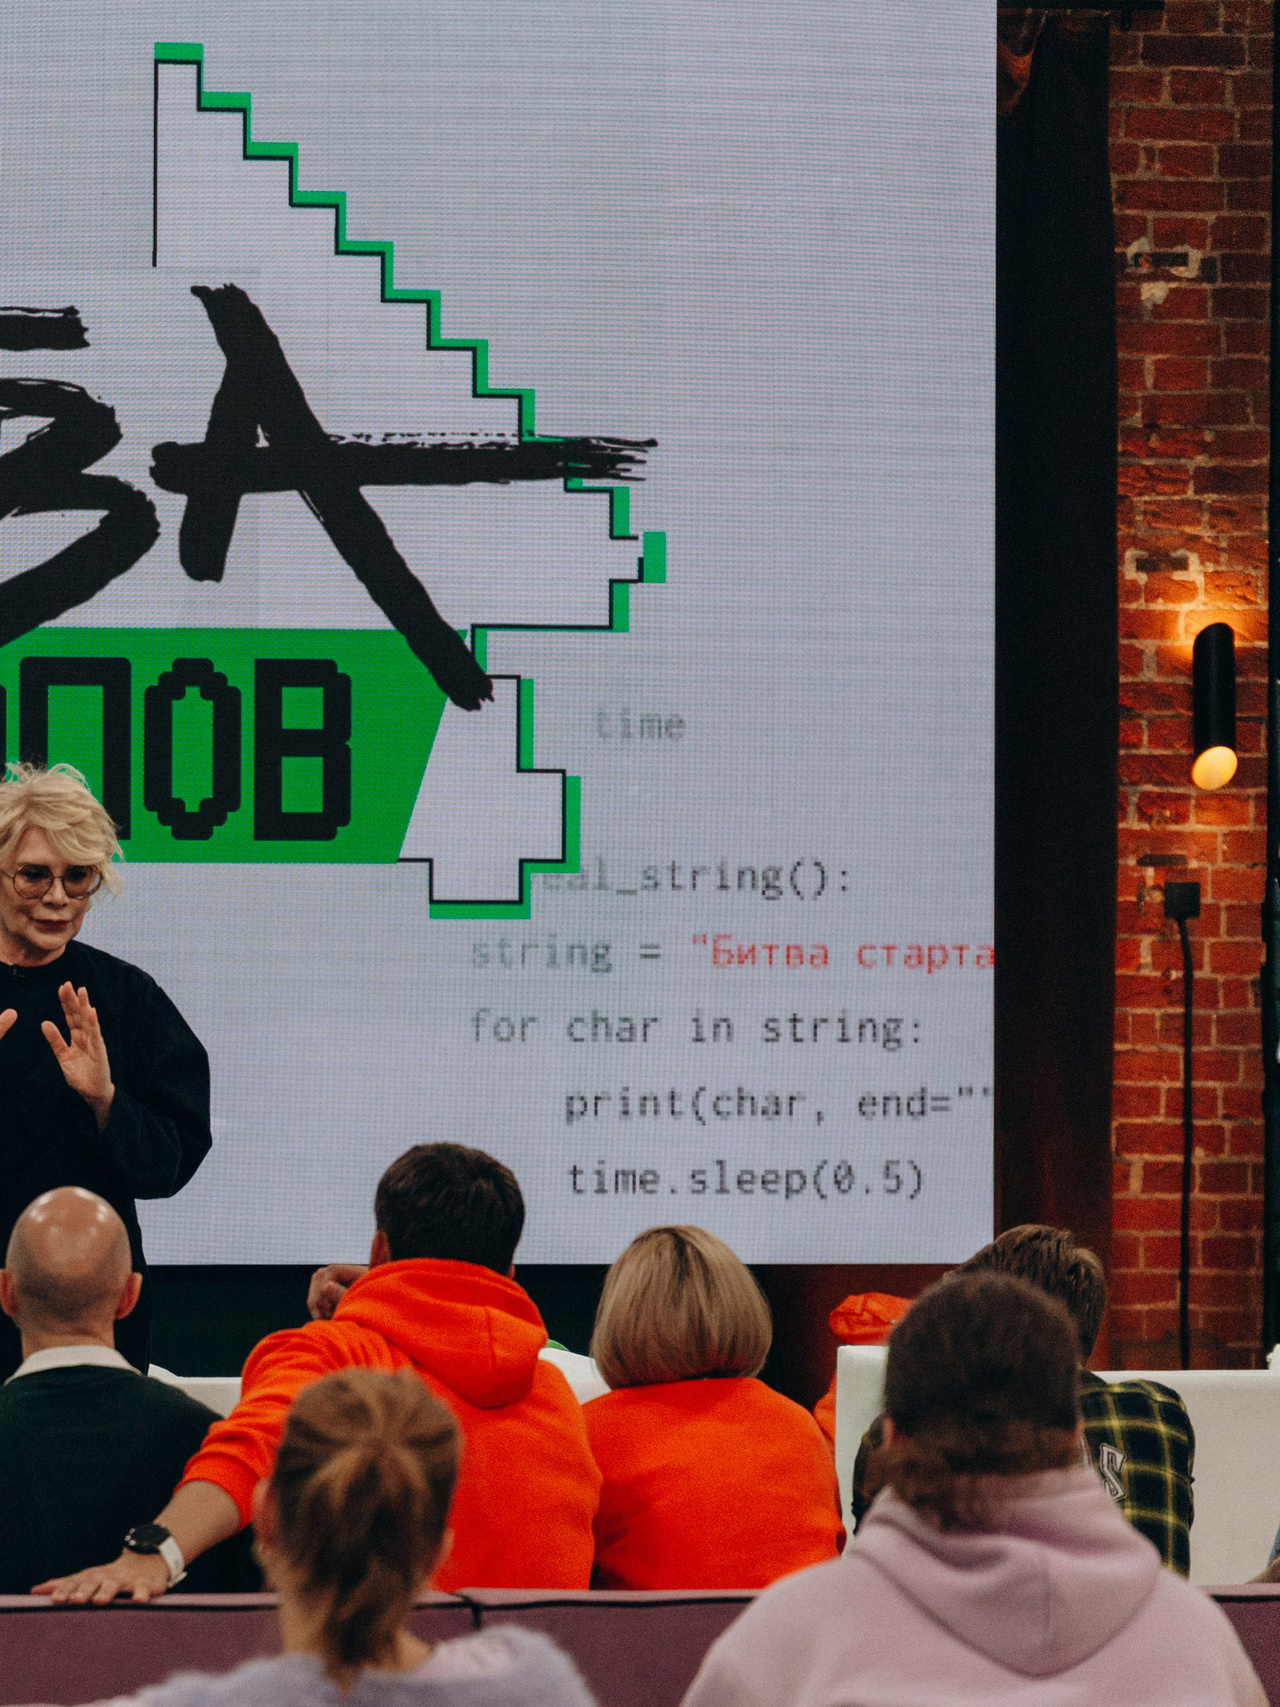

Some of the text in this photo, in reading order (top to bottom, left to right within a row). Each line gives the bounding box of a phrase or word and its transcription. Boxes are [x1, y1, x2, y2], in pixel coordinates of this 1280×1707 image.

[595, 708, 687, 740] time
[472, 933, 613, 973] string
[640, 943, 661, 959] =
[691, 933, 830, 970] "Битва
[472, 1007, 921, 1052] for char in string:
[565, 1085, 825, 1127] print(char,
[570, 1158, 924, 1200] time.sleep(0.5)
